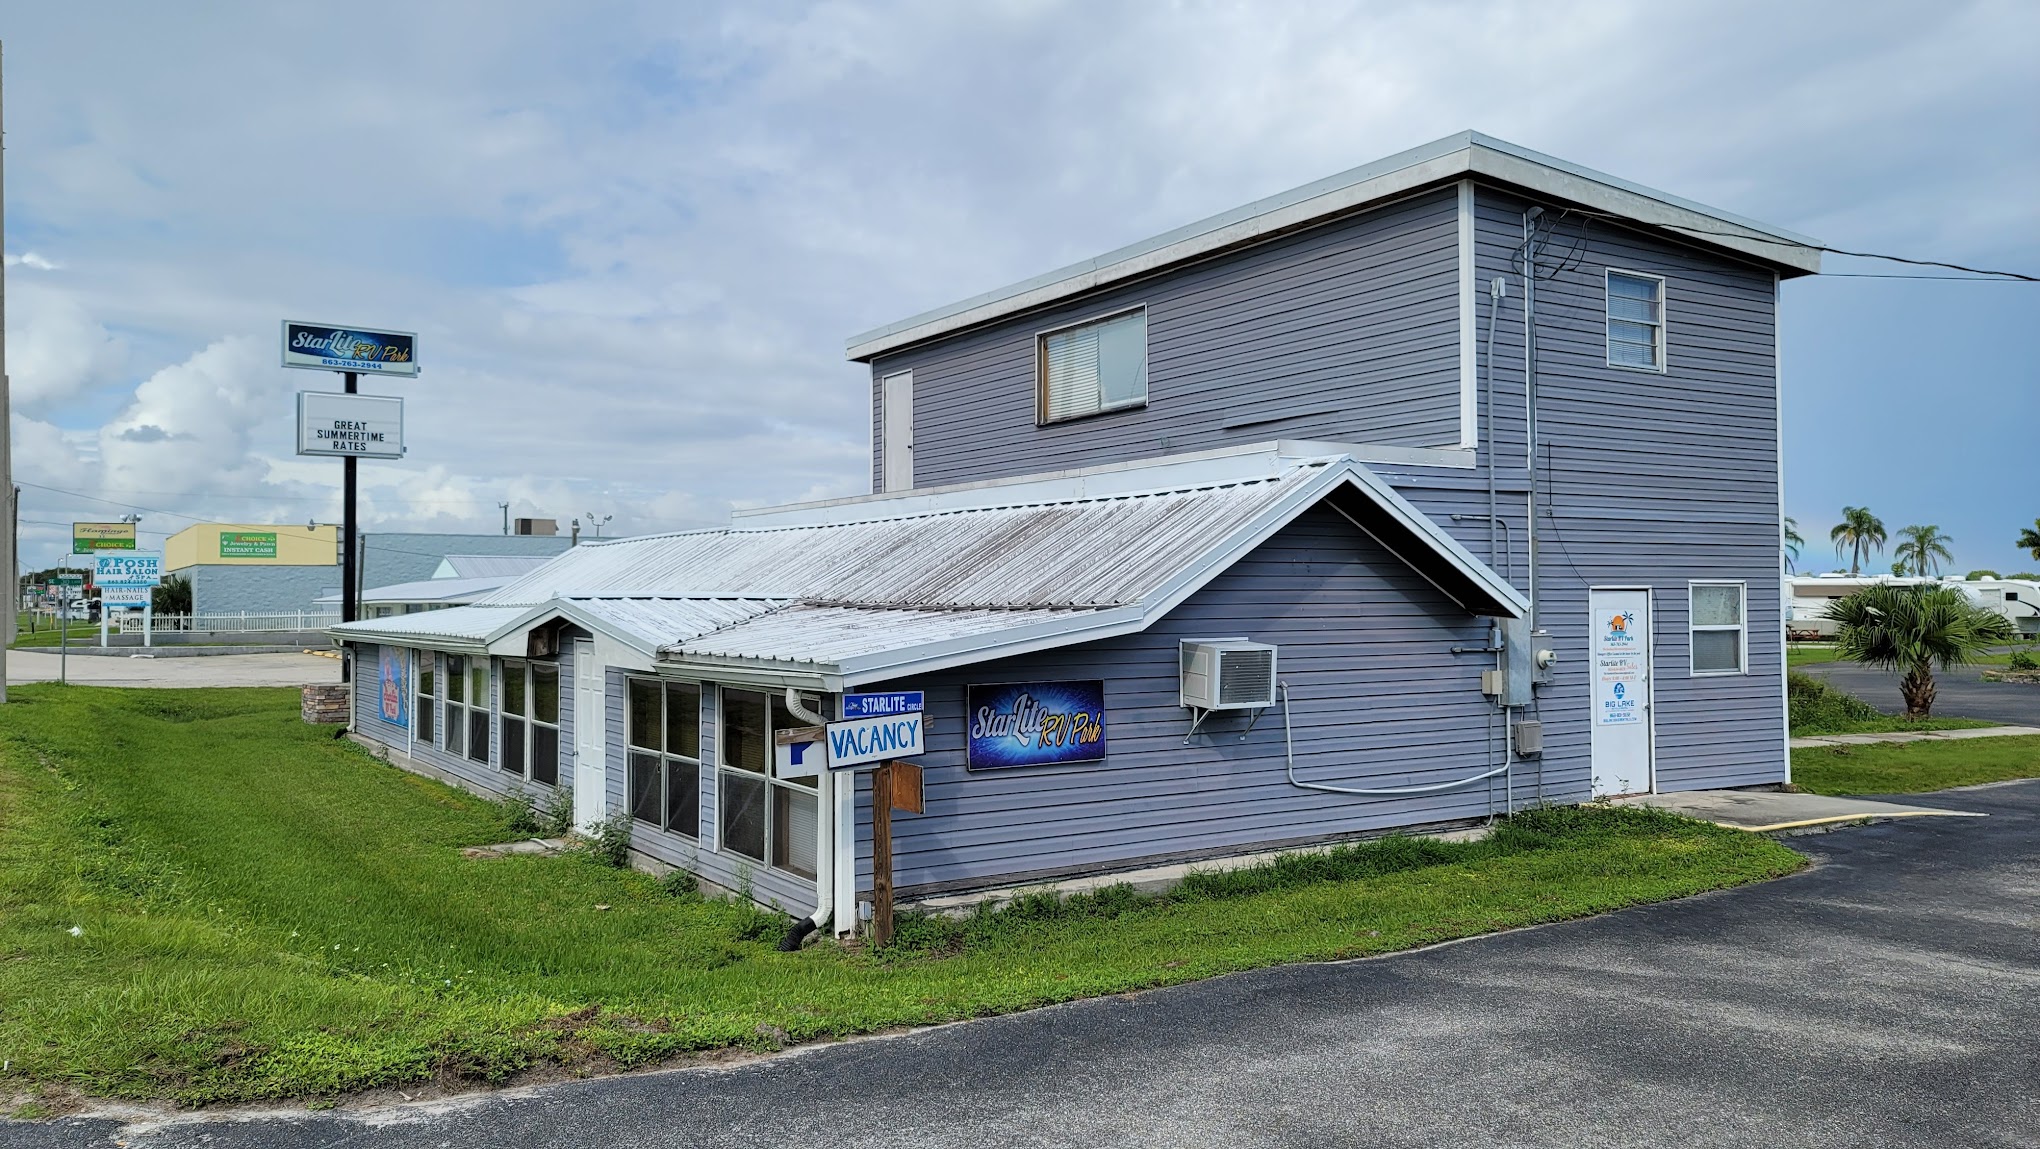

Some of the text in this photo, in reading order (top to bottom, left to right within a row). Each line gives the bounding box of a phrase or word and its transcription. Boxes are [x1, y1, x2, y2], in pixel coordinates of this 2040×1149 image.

[292, 330, 410, 363] StarLite RV Park
[322, 358, 382, 369] 863-763-2944
[334, 420, 367, 431] GREAT
[317, 429, 385, 442] SUMMERTIME
[333, 440, 367, 451] RATES
[114, 558, 158, 568] POSH
[96, 567, 158, 575] HAIR SALON
[862, 696, 906, 714] STARLITE
[906, 702, 922, 711] CIRCLE
[972, 693, 1102, 748] StarLite RV Park
[830, 719, 919, 759] VACANCY
